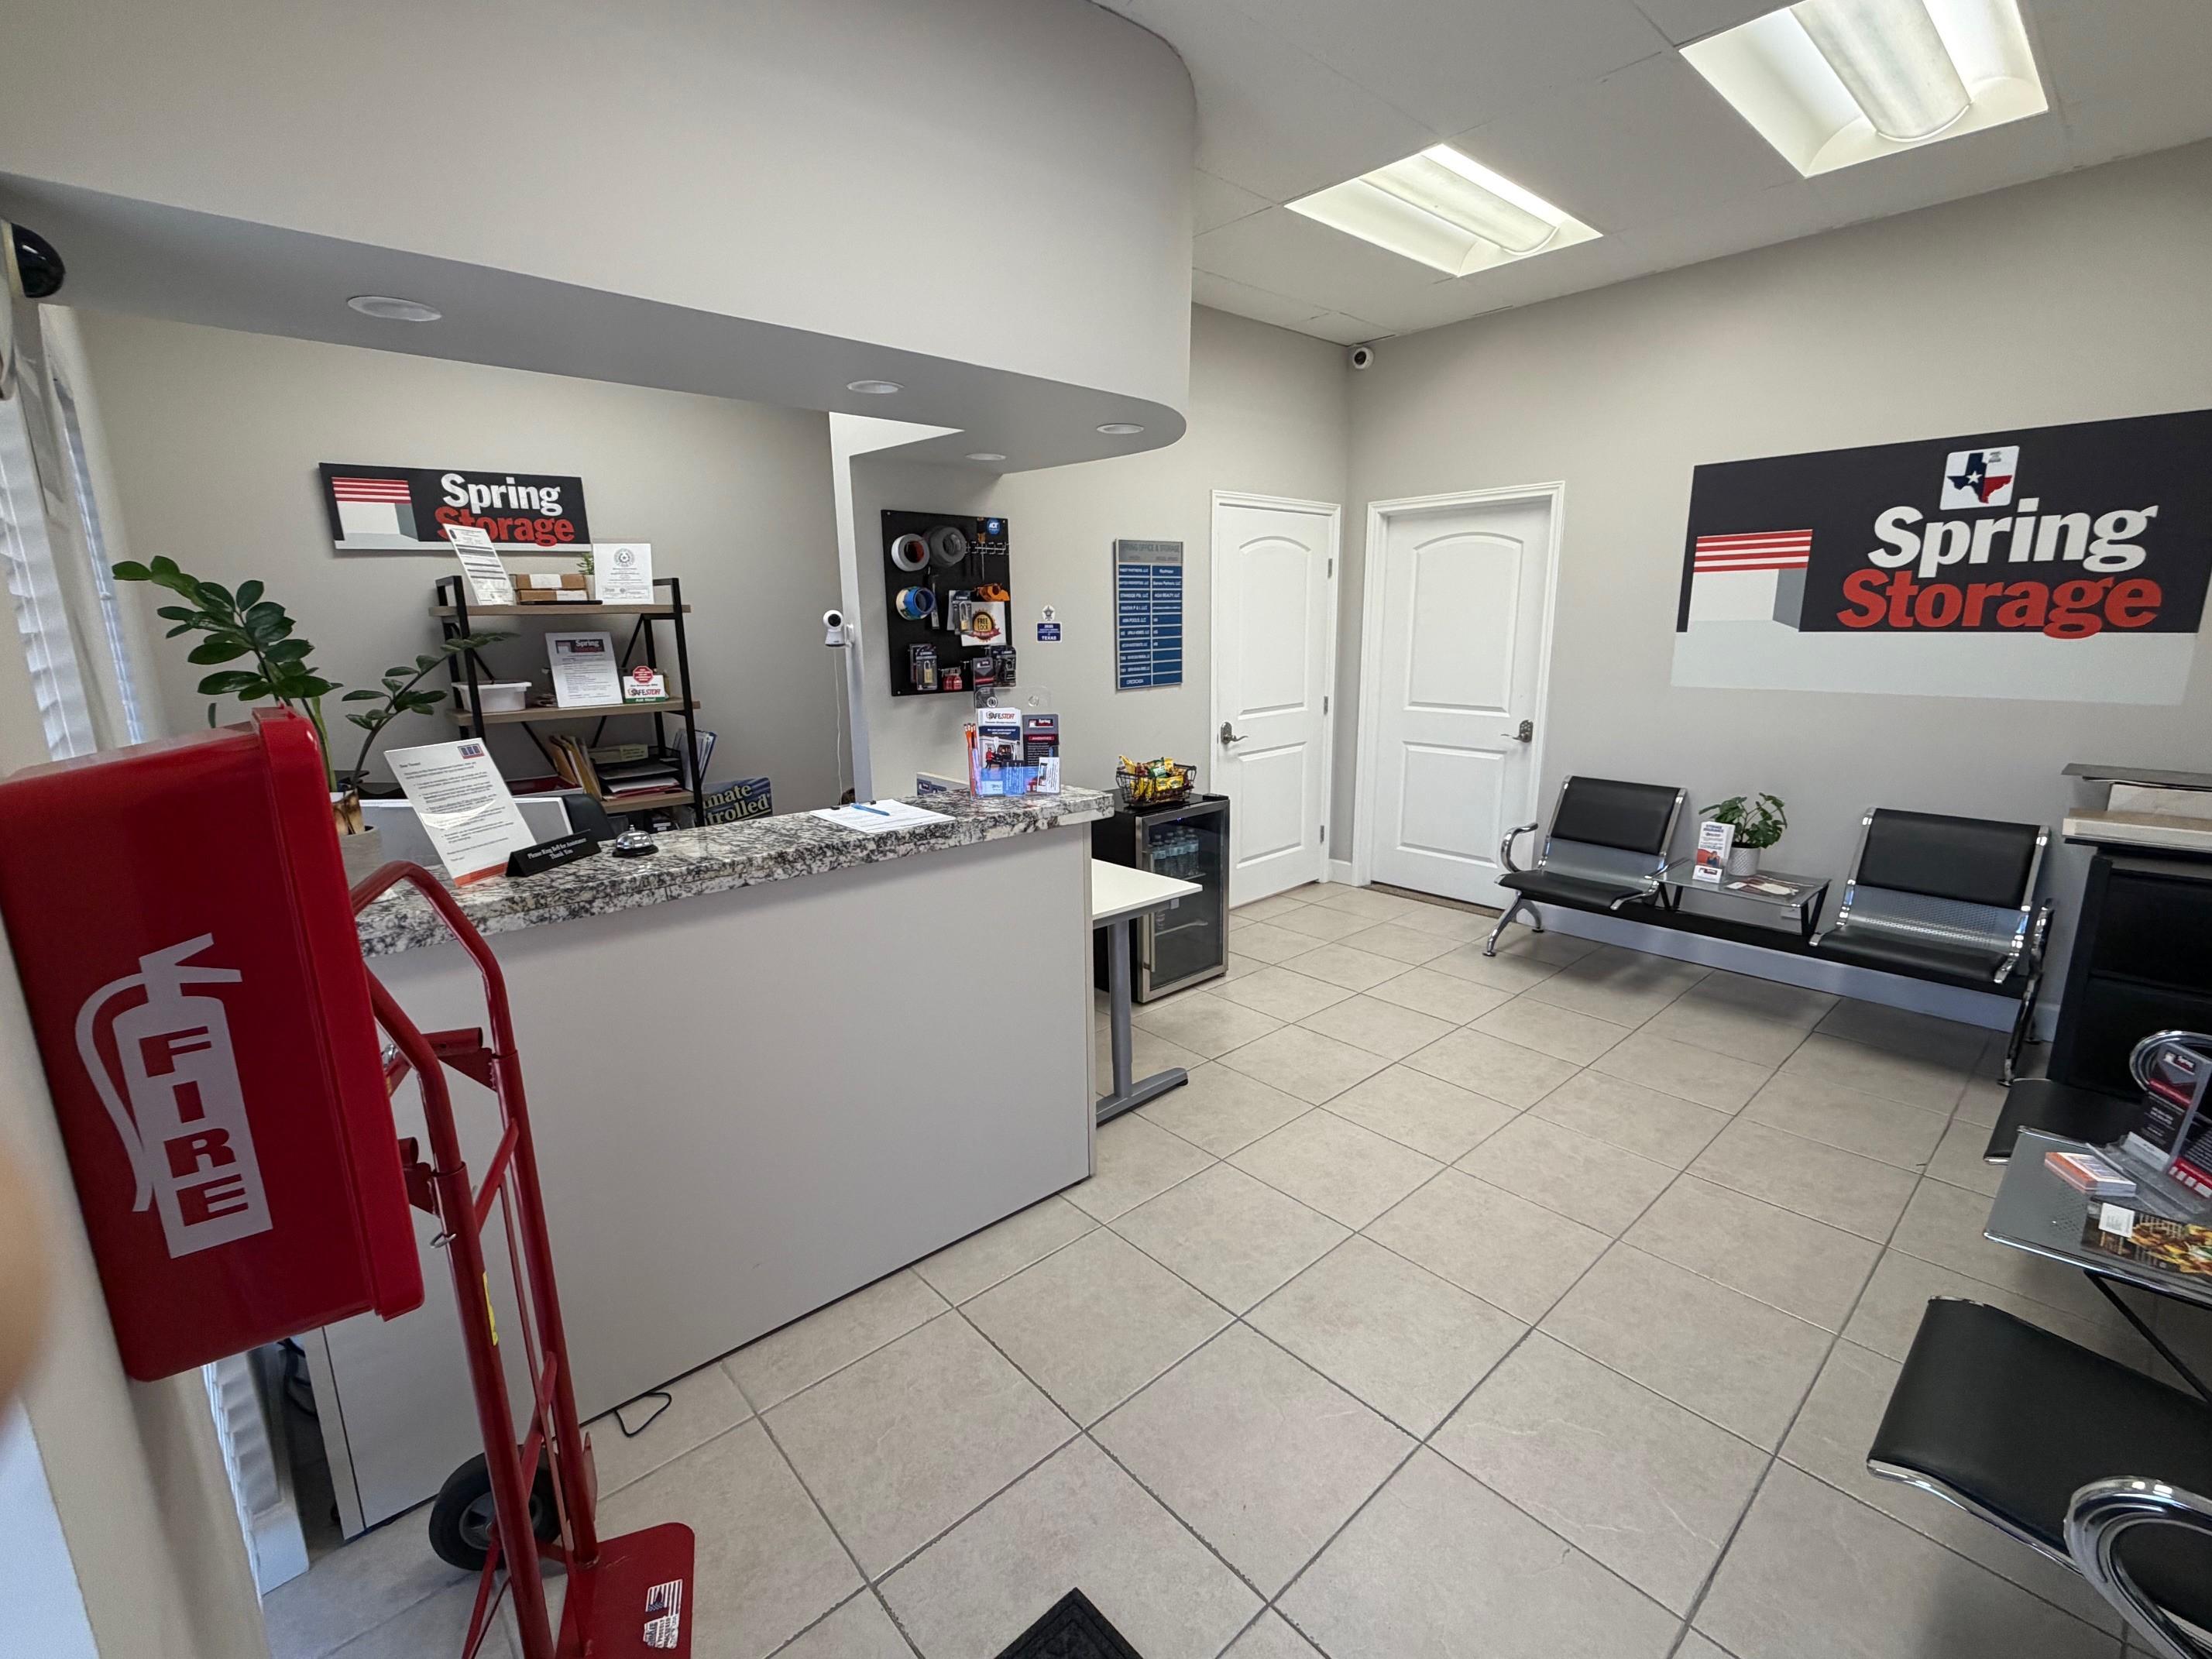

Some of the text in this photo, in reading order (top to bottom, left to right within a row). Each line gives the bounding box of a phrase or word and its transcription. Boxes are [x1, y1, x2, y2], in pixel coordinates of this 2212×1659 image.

[441, 473, 563, 517] Spring
[1867, 497, 2159, 579] Spring
[1836, 568, 2162, 639] Storage
[706, 792, 770, 825] trolled
[139, 1025, 249, 1227] FIRE
